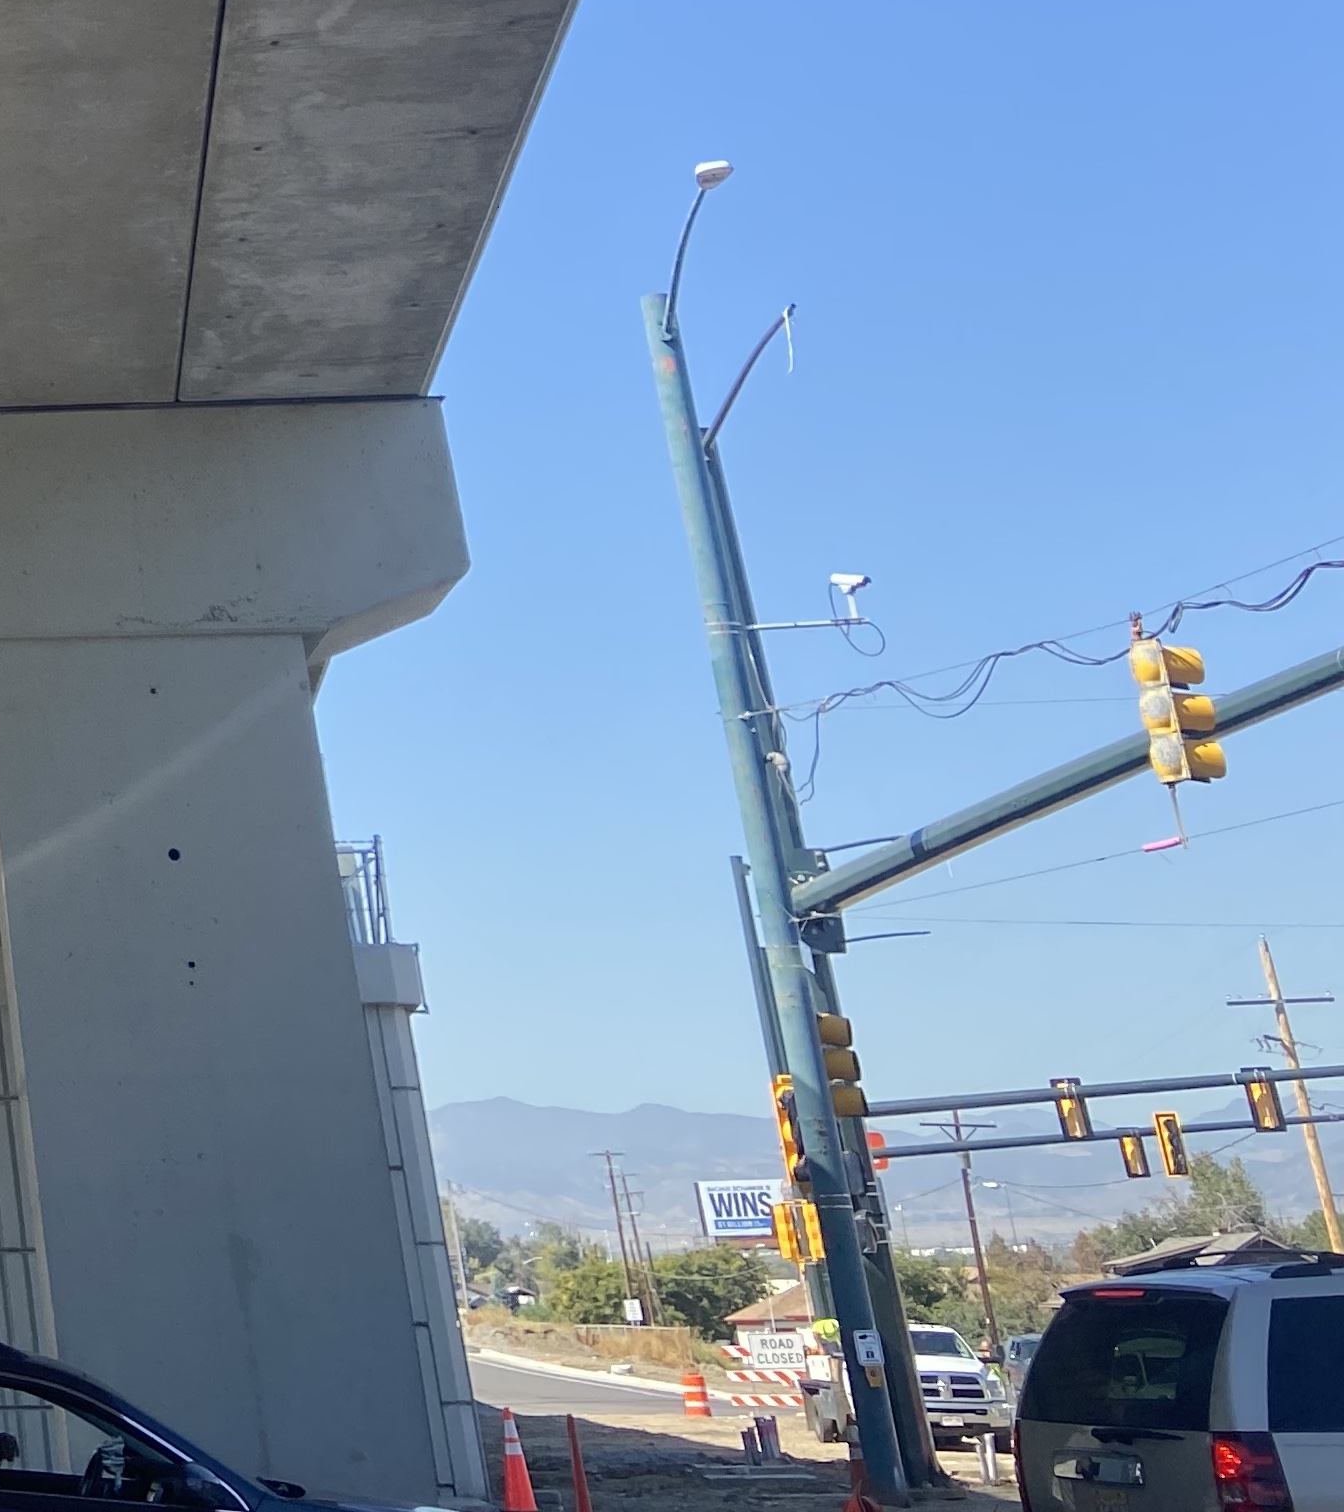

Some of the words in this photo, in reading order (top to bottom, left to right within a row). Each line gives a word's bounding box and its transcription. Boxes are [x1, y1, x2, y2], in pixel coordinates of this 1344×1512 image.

[709, 1192, 772, 1218] WINS
[760, 1338, 794, 1349] ROAD
[756, 1352, 804, 1364] CLOSED
